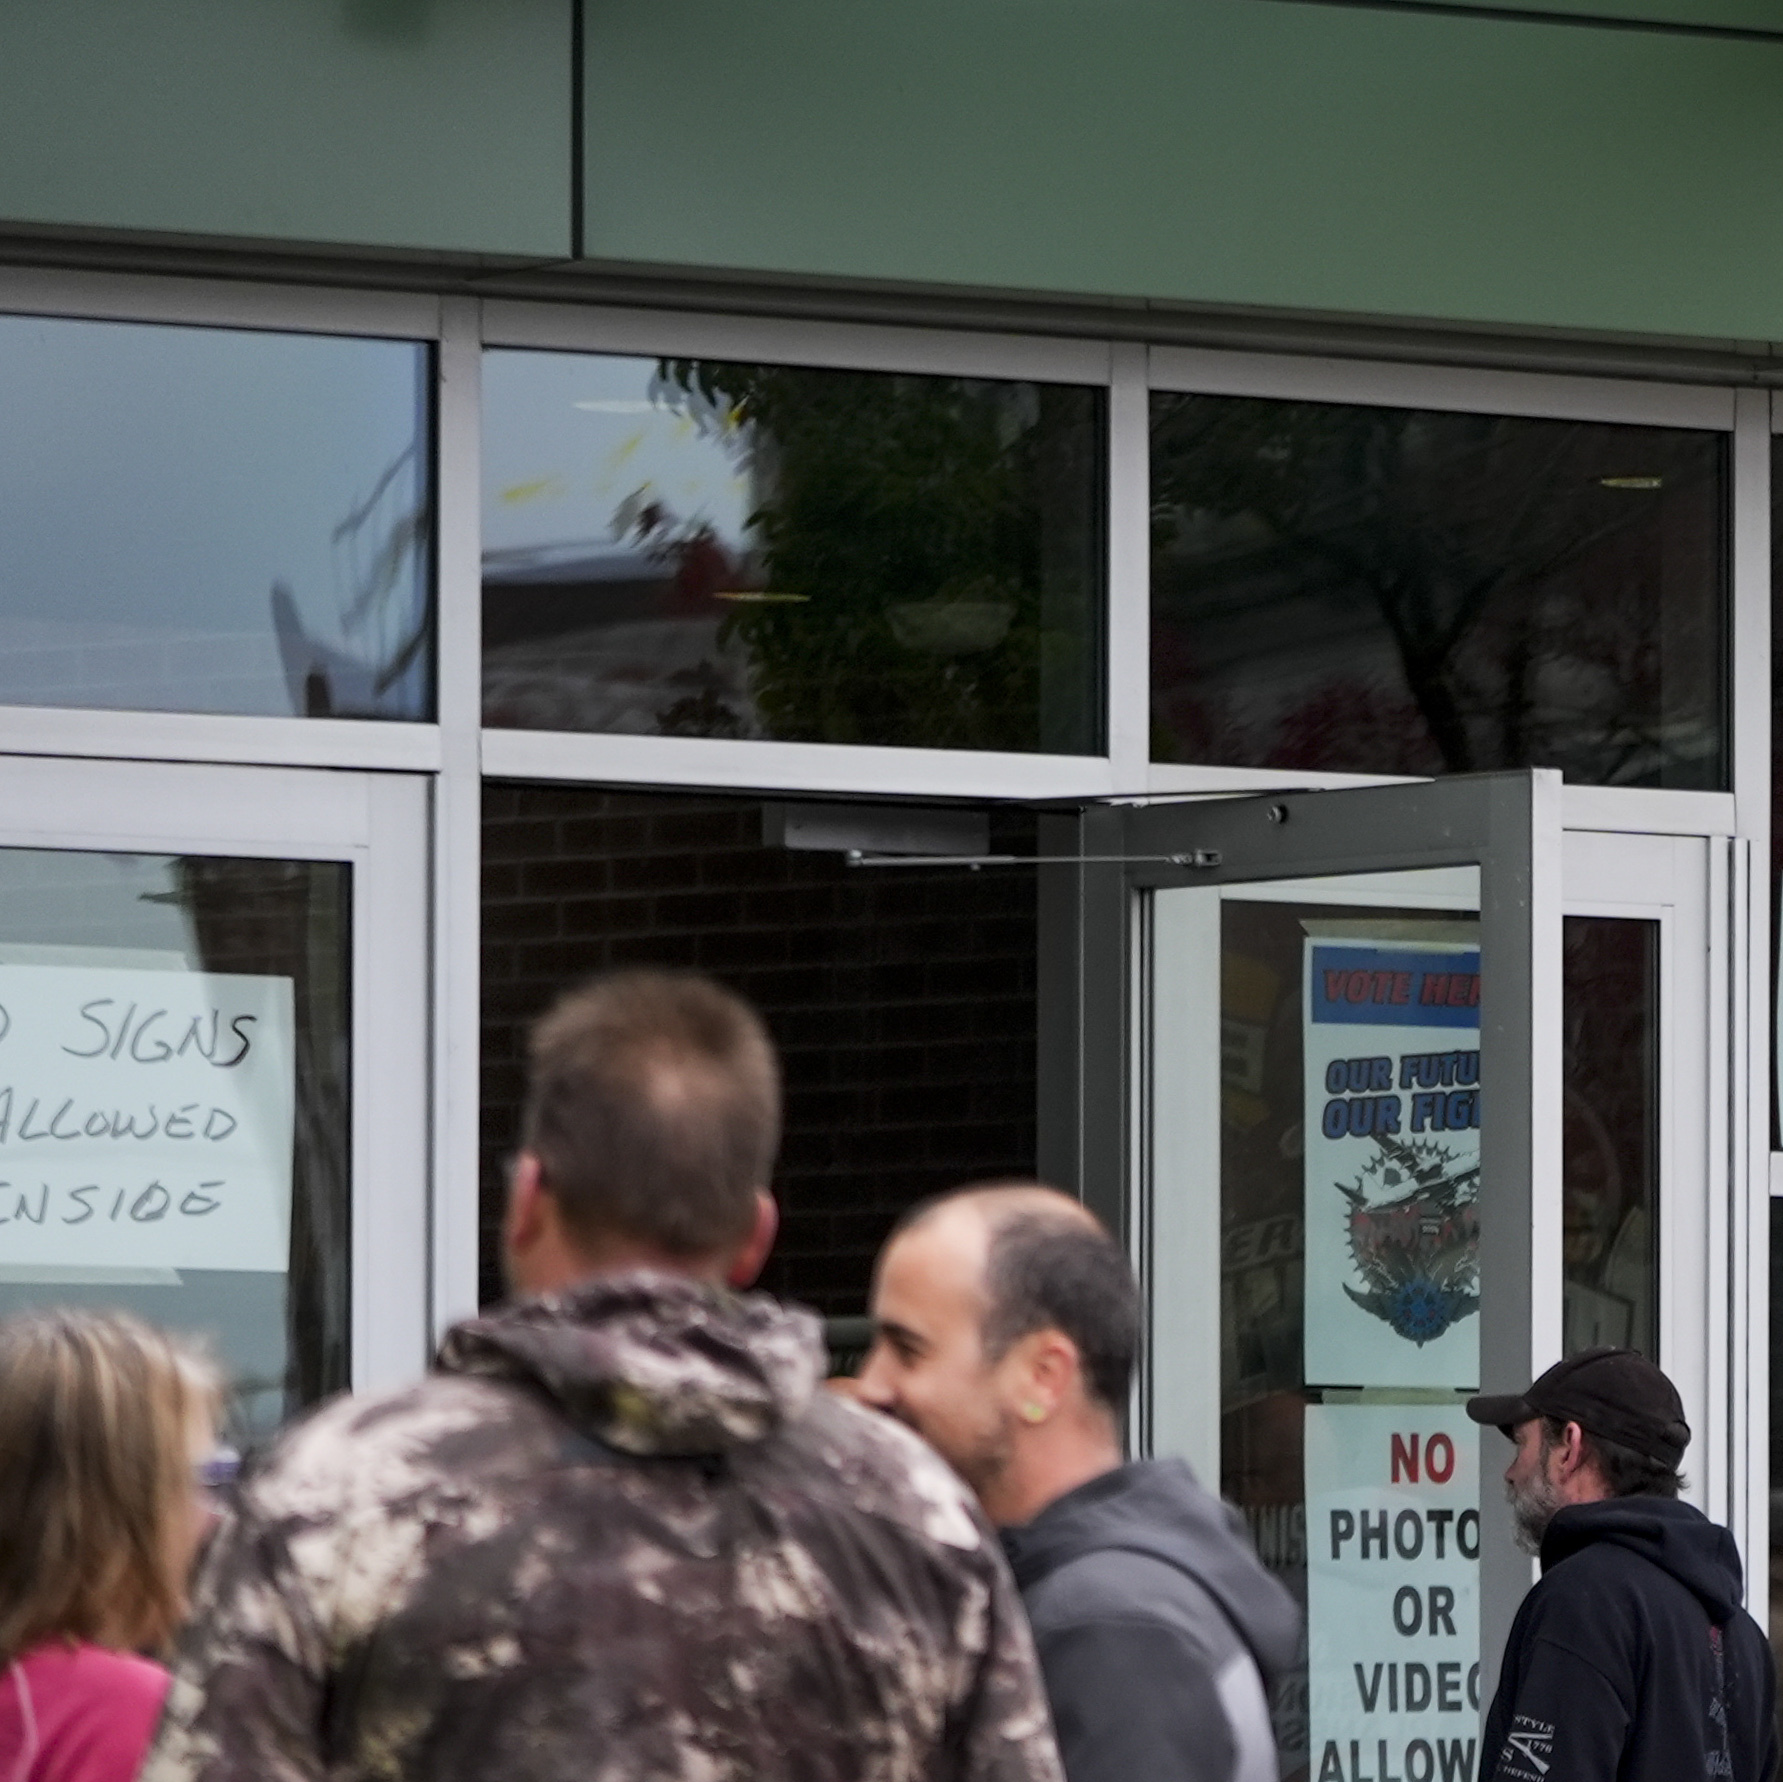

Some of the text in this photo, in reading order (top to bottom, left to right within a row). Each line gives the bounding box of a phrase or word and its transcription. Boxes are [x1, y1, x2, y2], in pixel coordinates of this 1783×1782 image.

[1324, 969, 1412, 1005] VOTE
[60, 997, 257, 1068] SIGNS
[1325, 1055, 1393, 1094] OUR
[1322, 1094, 1402, 1139] OUR
[1390, 1432, 1455, 1485] NO
[1329, 1509, 1480, 1561] PHOTO
[1392, 1585, 1457, 1637] OR
